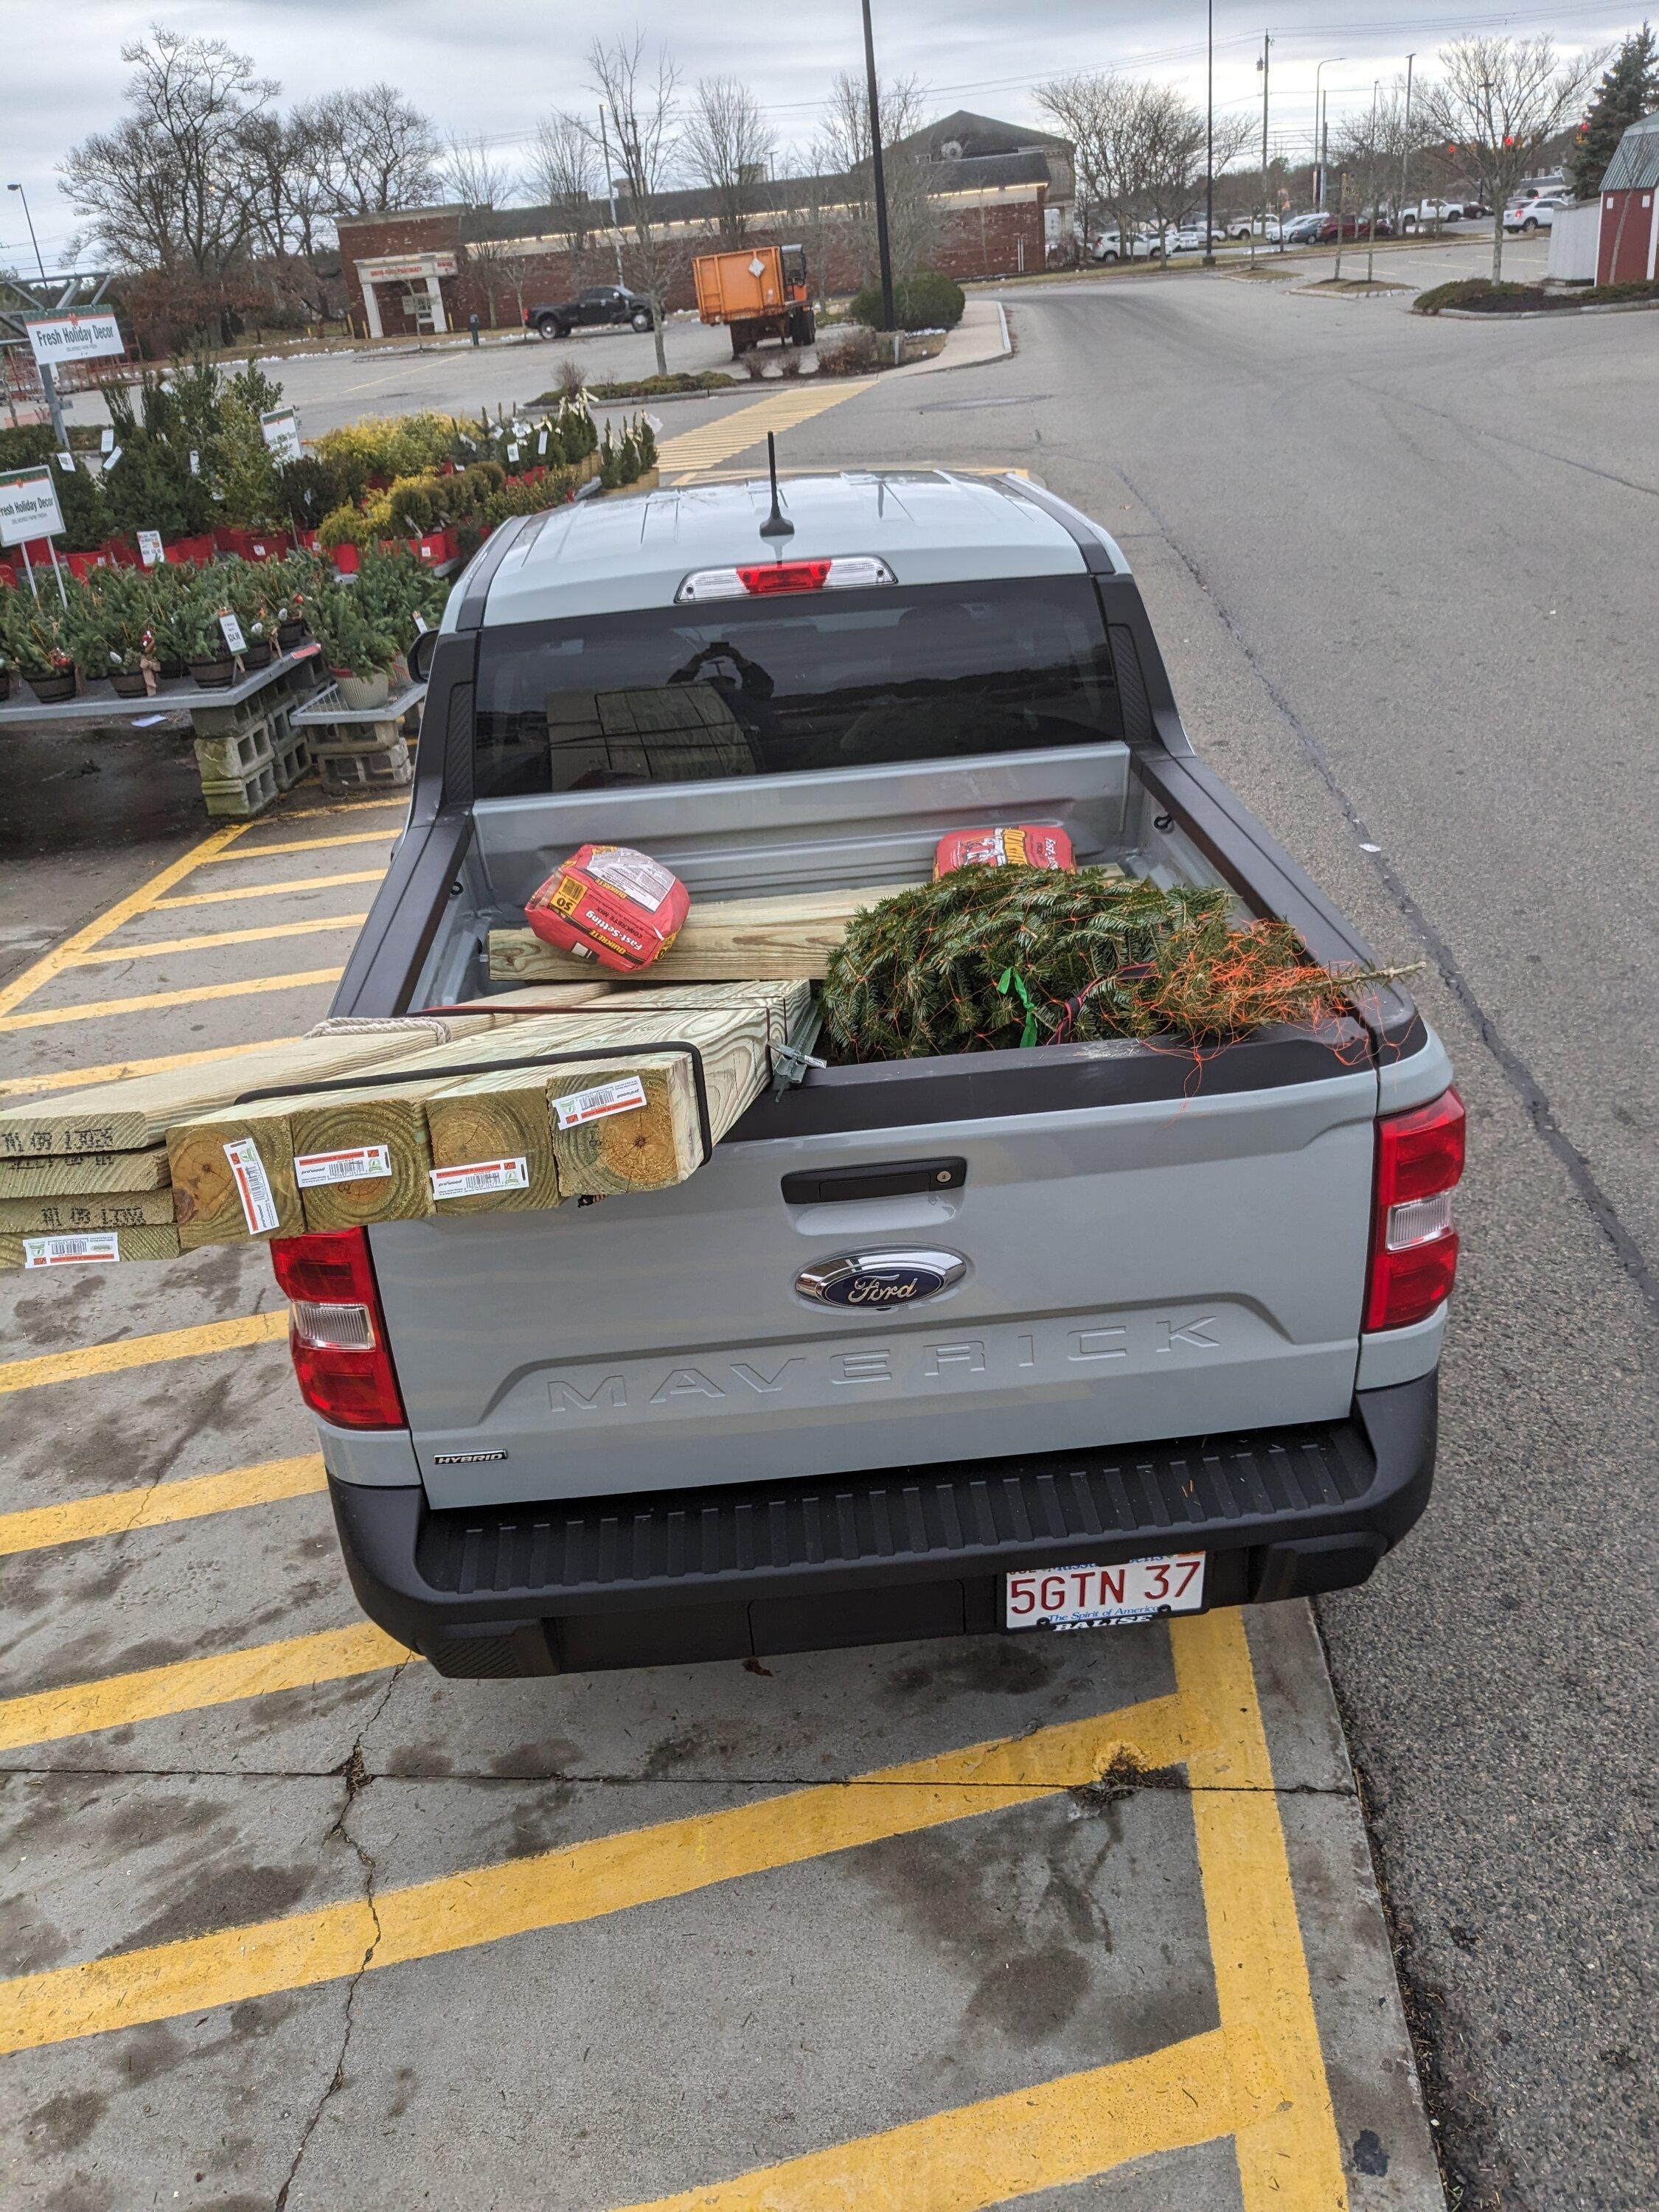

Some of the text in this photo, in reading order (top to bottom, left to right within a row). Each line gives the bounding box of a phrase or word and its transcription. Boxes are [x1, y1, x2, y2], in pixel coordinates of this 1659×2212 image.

[37, 324, 114, 347] Fresh Holiday Decor
[0, 495, 54, 516] resh Holiday Decor
[557, 897, 572, 911] 50
[595, 906, 609, 918] MIX
[585, 910, 643, 950] Fast-Setting
[609, 916, 643, 939] CONCRETE
[589, 930, 627, 955] QUIKRETE
[848, 1274, 917, 1303] Ford
[546, 1315, 1220, 1413] MAVERICK
[438, 1453, 503, 1464] HYBRID
[1011, 1561, 1202, 1614] 5GTN 37
[1053, 1615, 1152, 1632] BALISE
[1071, 1611, 1099, 1621] Spirit
[1116, 1606, 1159, 1615] America
